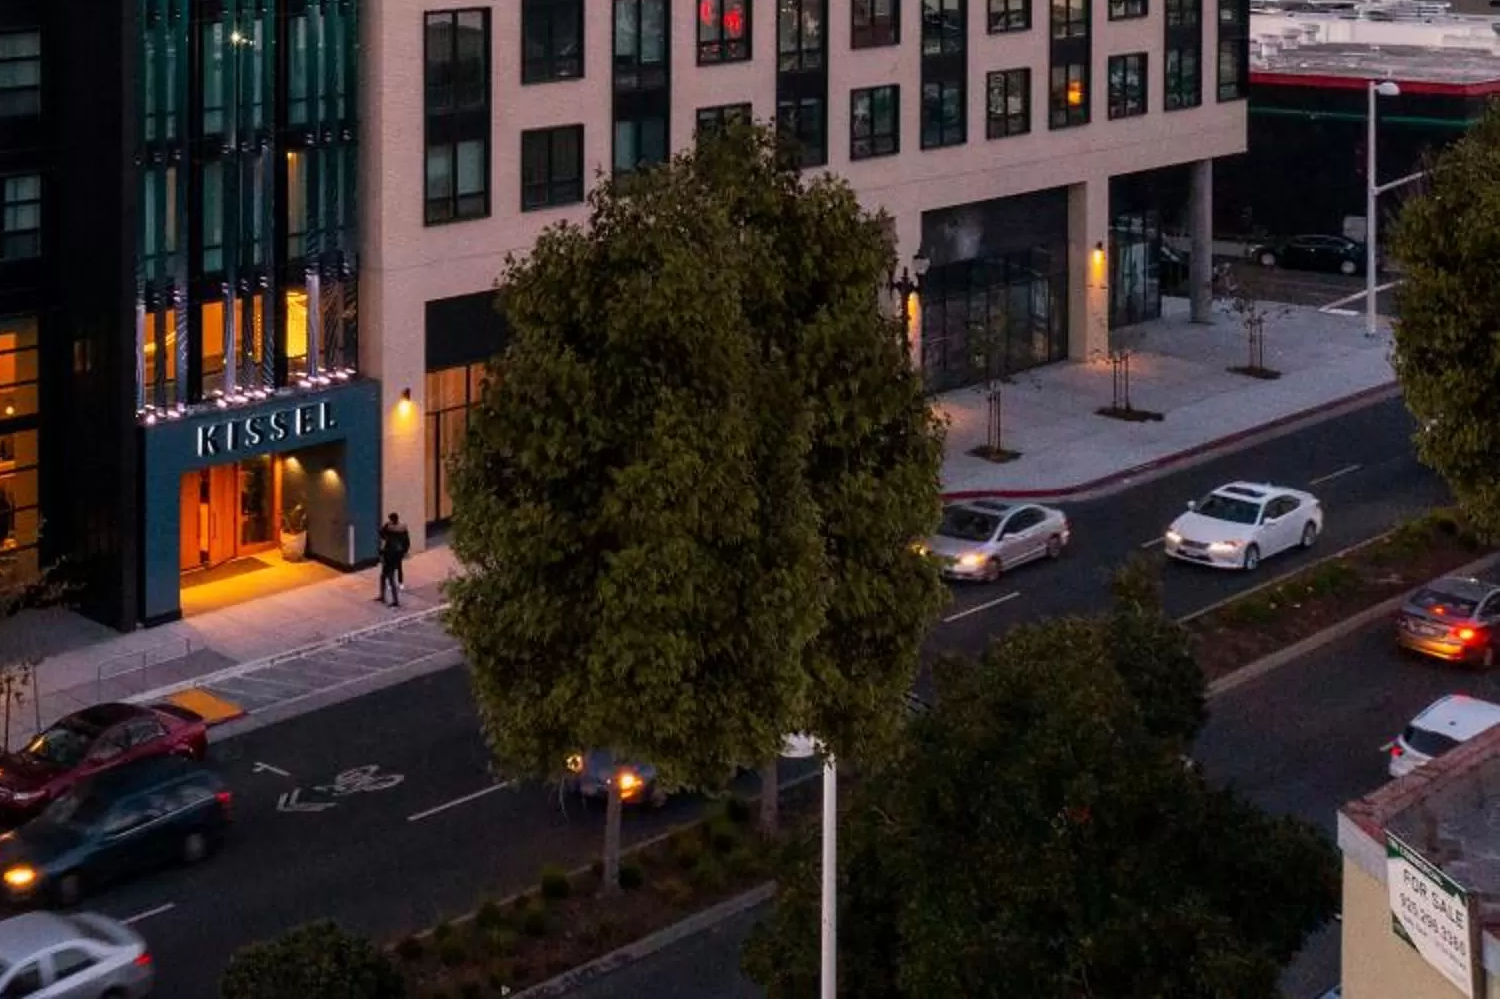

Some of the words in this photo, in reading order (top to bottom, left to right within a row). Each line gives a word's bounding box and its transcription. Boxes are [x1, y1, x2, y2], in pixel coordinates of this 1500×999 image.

[197, 402, 337, 457] KISSEL
[1404, 869, 1427, 897] FOR
[1431, 892, 1464, 930] SALE
